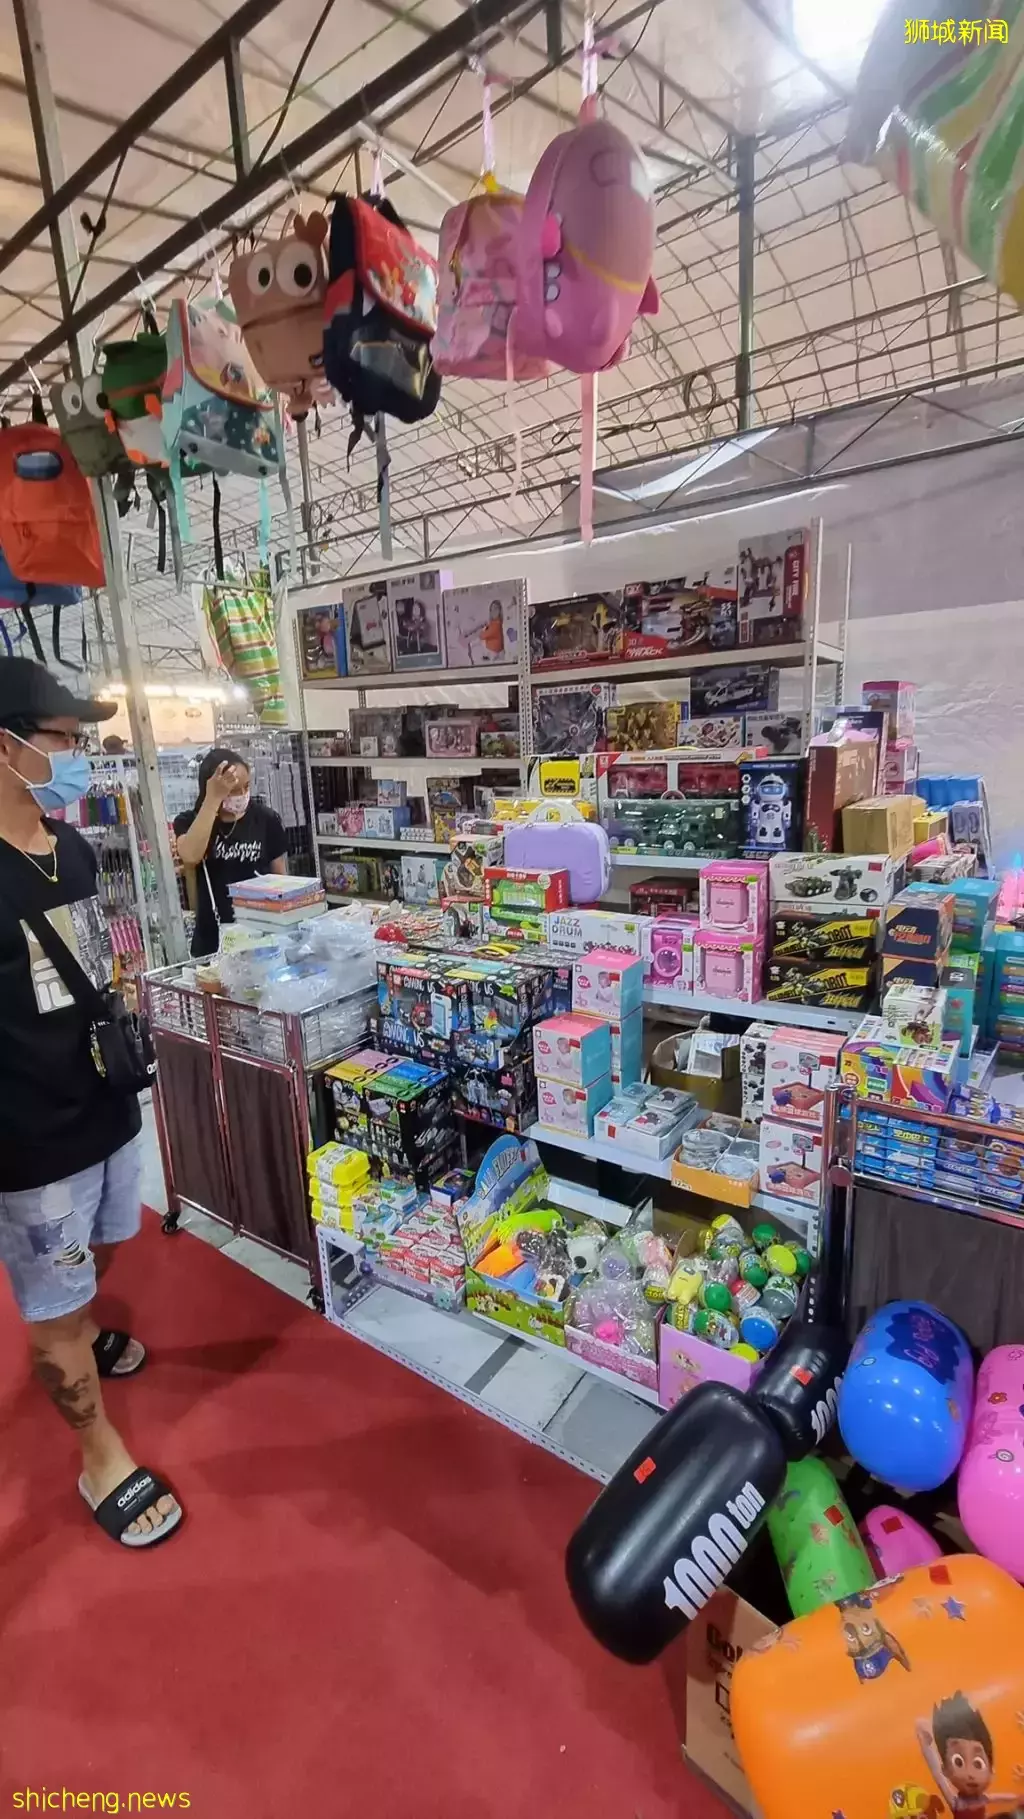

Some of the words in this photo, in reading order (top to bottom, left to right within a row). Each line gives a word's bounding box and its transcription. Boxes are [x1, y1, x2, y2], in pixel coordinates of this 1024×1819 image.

[552, 925, 582, 937] DRUM
[554, 915, 580, 927] JAZZ
[117, 1476, 152, 1507] adidas
[663, 1512, 748, 1621] 1000
[726, 1481, 766, 1529] ton
